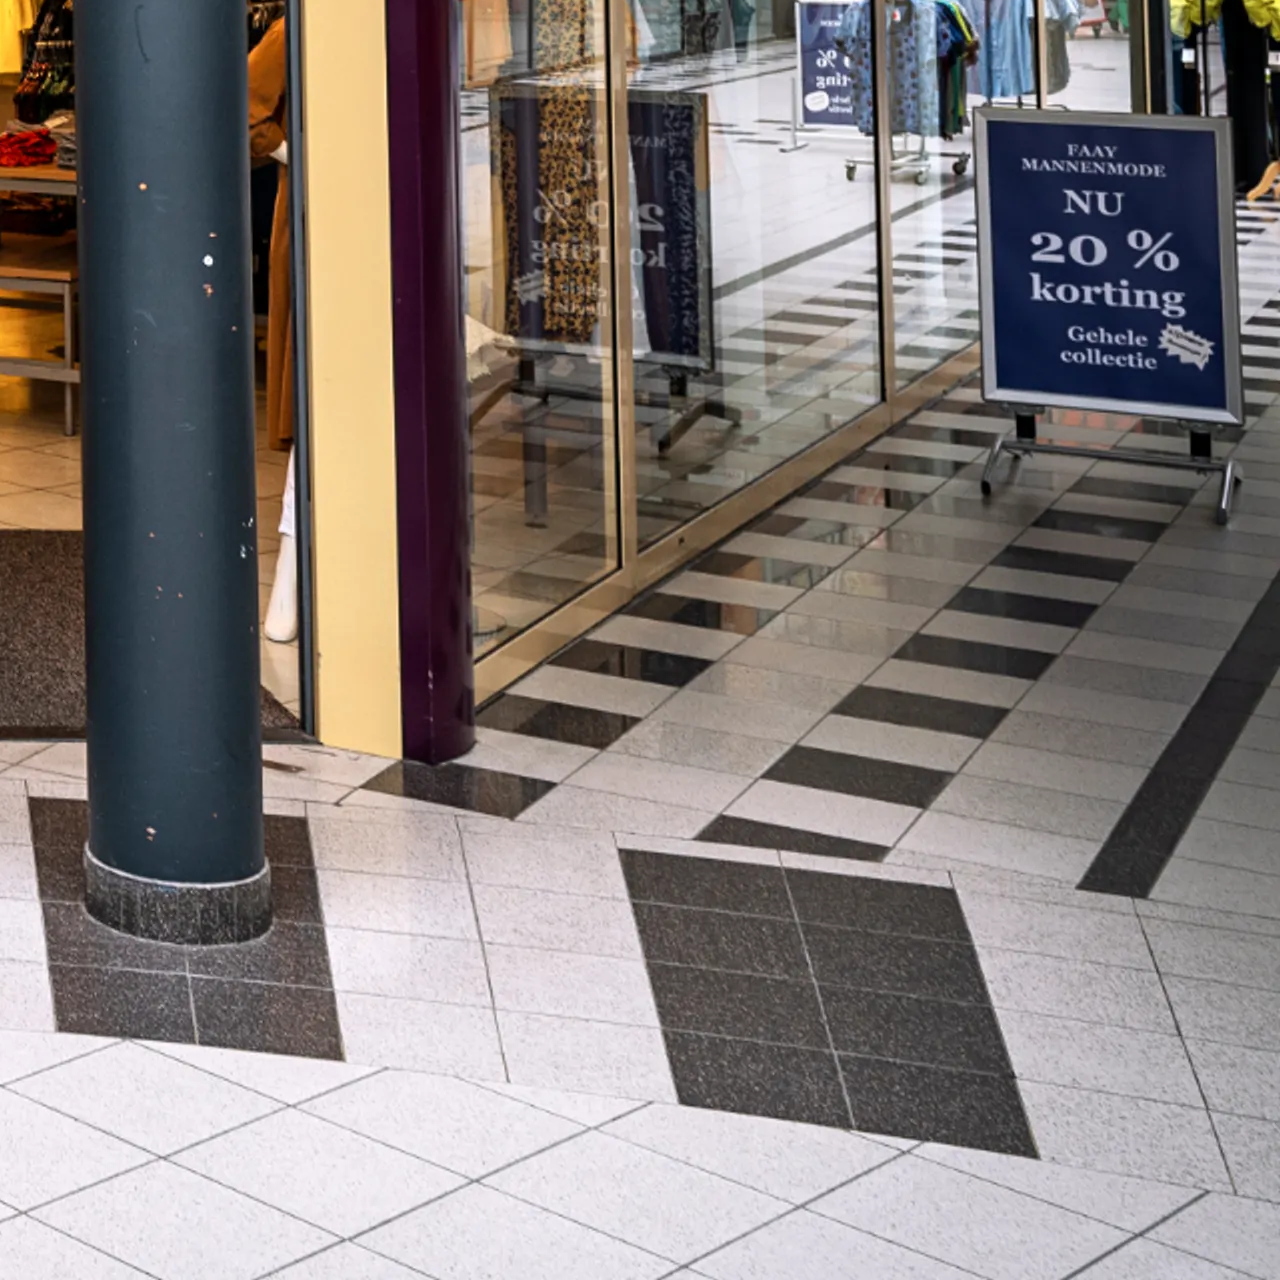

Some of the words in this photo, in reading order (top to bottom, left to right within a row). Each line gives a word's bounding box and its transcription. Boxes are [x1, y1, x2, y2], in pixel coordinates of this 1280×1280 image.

[1067, 143, 1118, 158] FAAY
[1021, 158, 1167, 178] MANNENMODE
[1062, 188, 1125, 216] NU
[1030, 231, 1108, 266] 20
[1126, 229, 1180, 271] %
[1029, 272, 1187, 319] korting
[1067, 325, 1149, 347] Gehele
[1060, 348, 1158, 370] collectie
